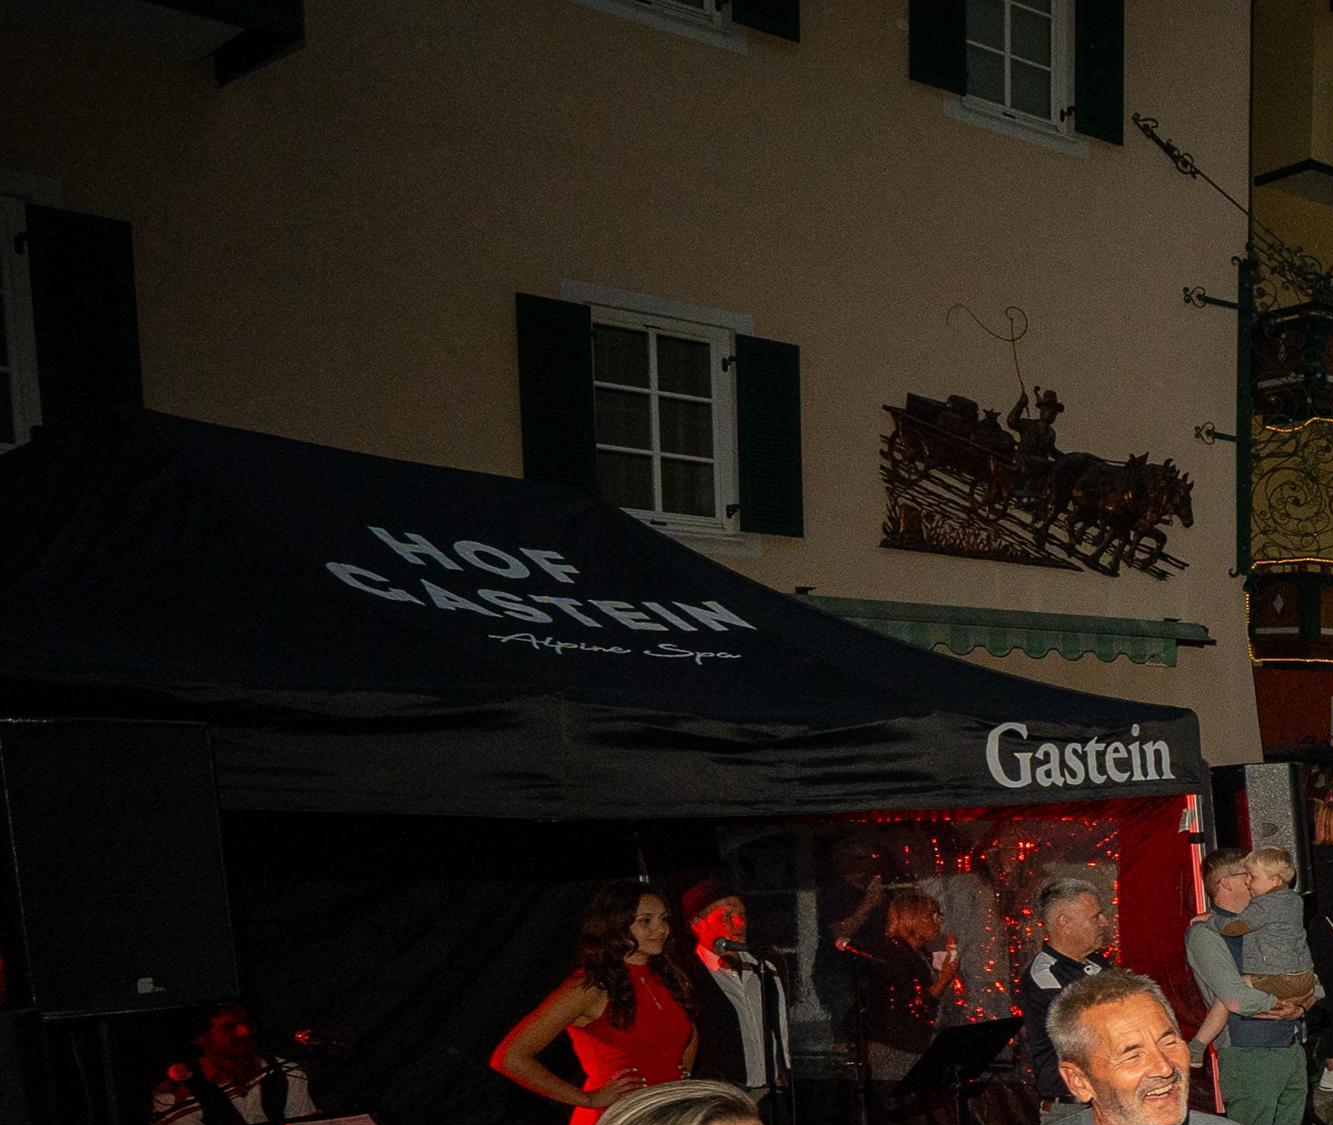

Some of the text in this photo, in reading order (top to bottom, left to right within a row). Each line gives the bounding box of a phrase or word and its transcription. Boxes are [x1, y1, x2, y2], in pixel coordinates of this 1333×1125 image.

[366, 525, 581, 584] HOF
[325, 561, 758, 632] GASTEIN
[488, 632, 742, 666] Alpine Spa
[985, 721, 1176, 789] Gastein
